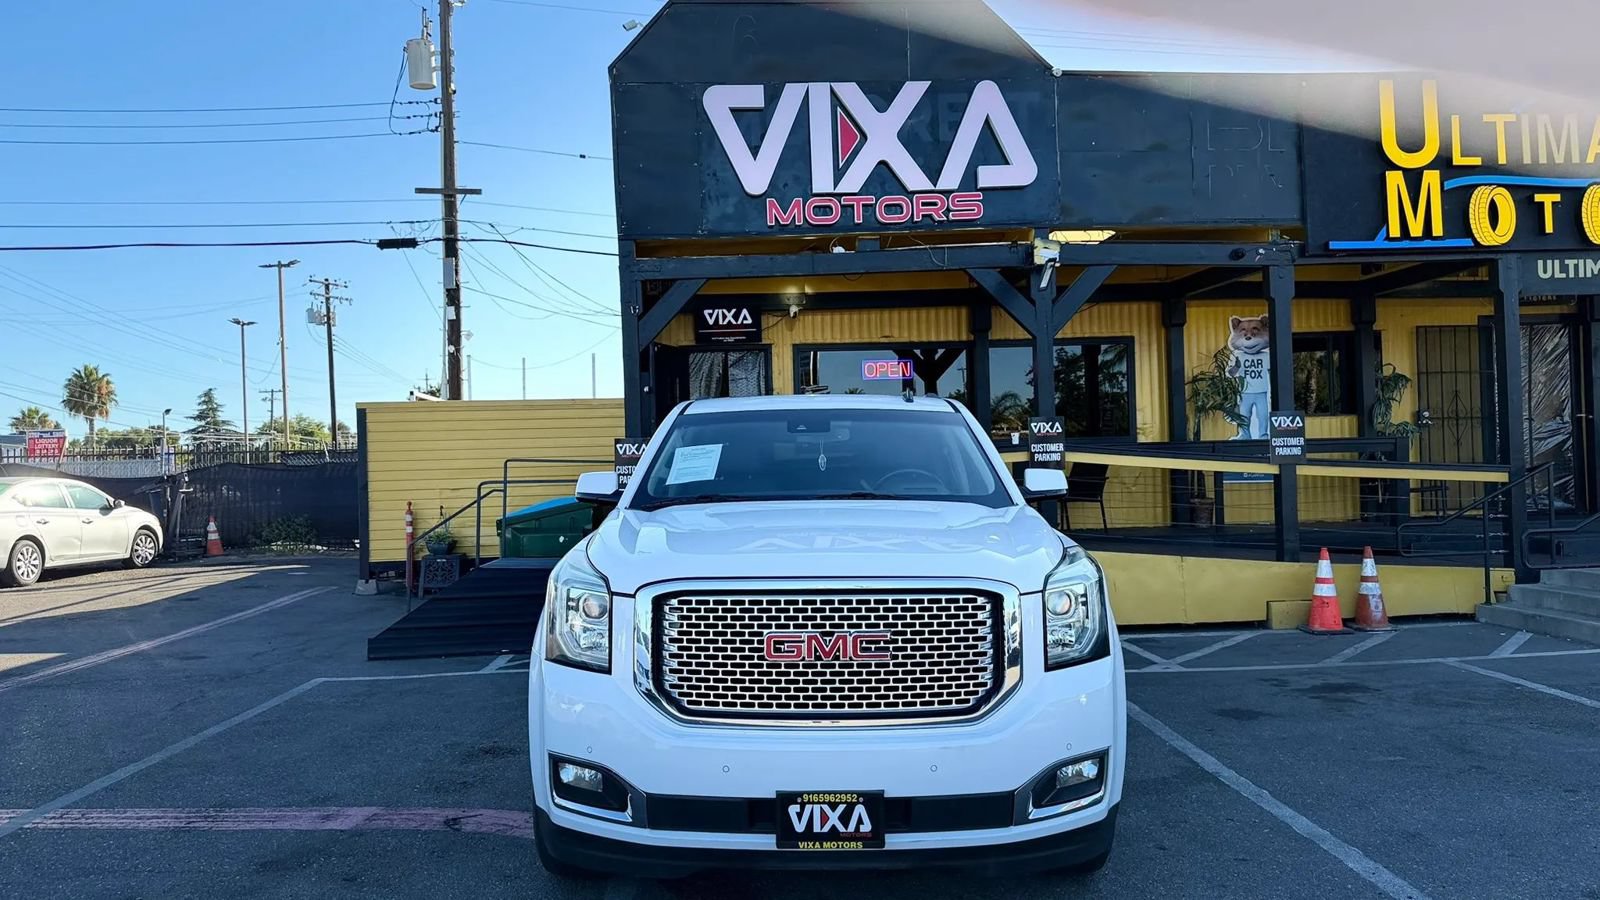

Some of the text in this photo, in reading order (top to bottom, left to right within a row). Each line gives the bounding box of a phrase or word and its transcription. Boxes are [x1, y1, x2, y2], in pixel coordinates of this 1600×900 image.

[702, 80, 1038, 196] VIXA
[766, 191, 984, 226] MOTORS
[703, 308, 753, 326] VIXA
[1243, 358, 1264, 369] CAR
[863, 362, 911, 378] OPEN
[1243, 369, 1263, 380] FOX
[1031, 421, 1063, 433] VIXA
[1271, 416, 1303, 427] VIXA
[1271, 437, 1305, 446] CUSTOMER
[1031, 443, 1064, 453] CUSTOMER
[1275, 446, 1302, 455] PARKING
[1034, 453, 1061, 461] PARKING
[616, 465, 637, 474] CUSTO
[764, 631, 892, 661] GMC
[802, 793, 858, 803] 9165962952
[787, 803, 872, 833] VIXA
[798, 841, 863, 849] VIXA MOTORS
